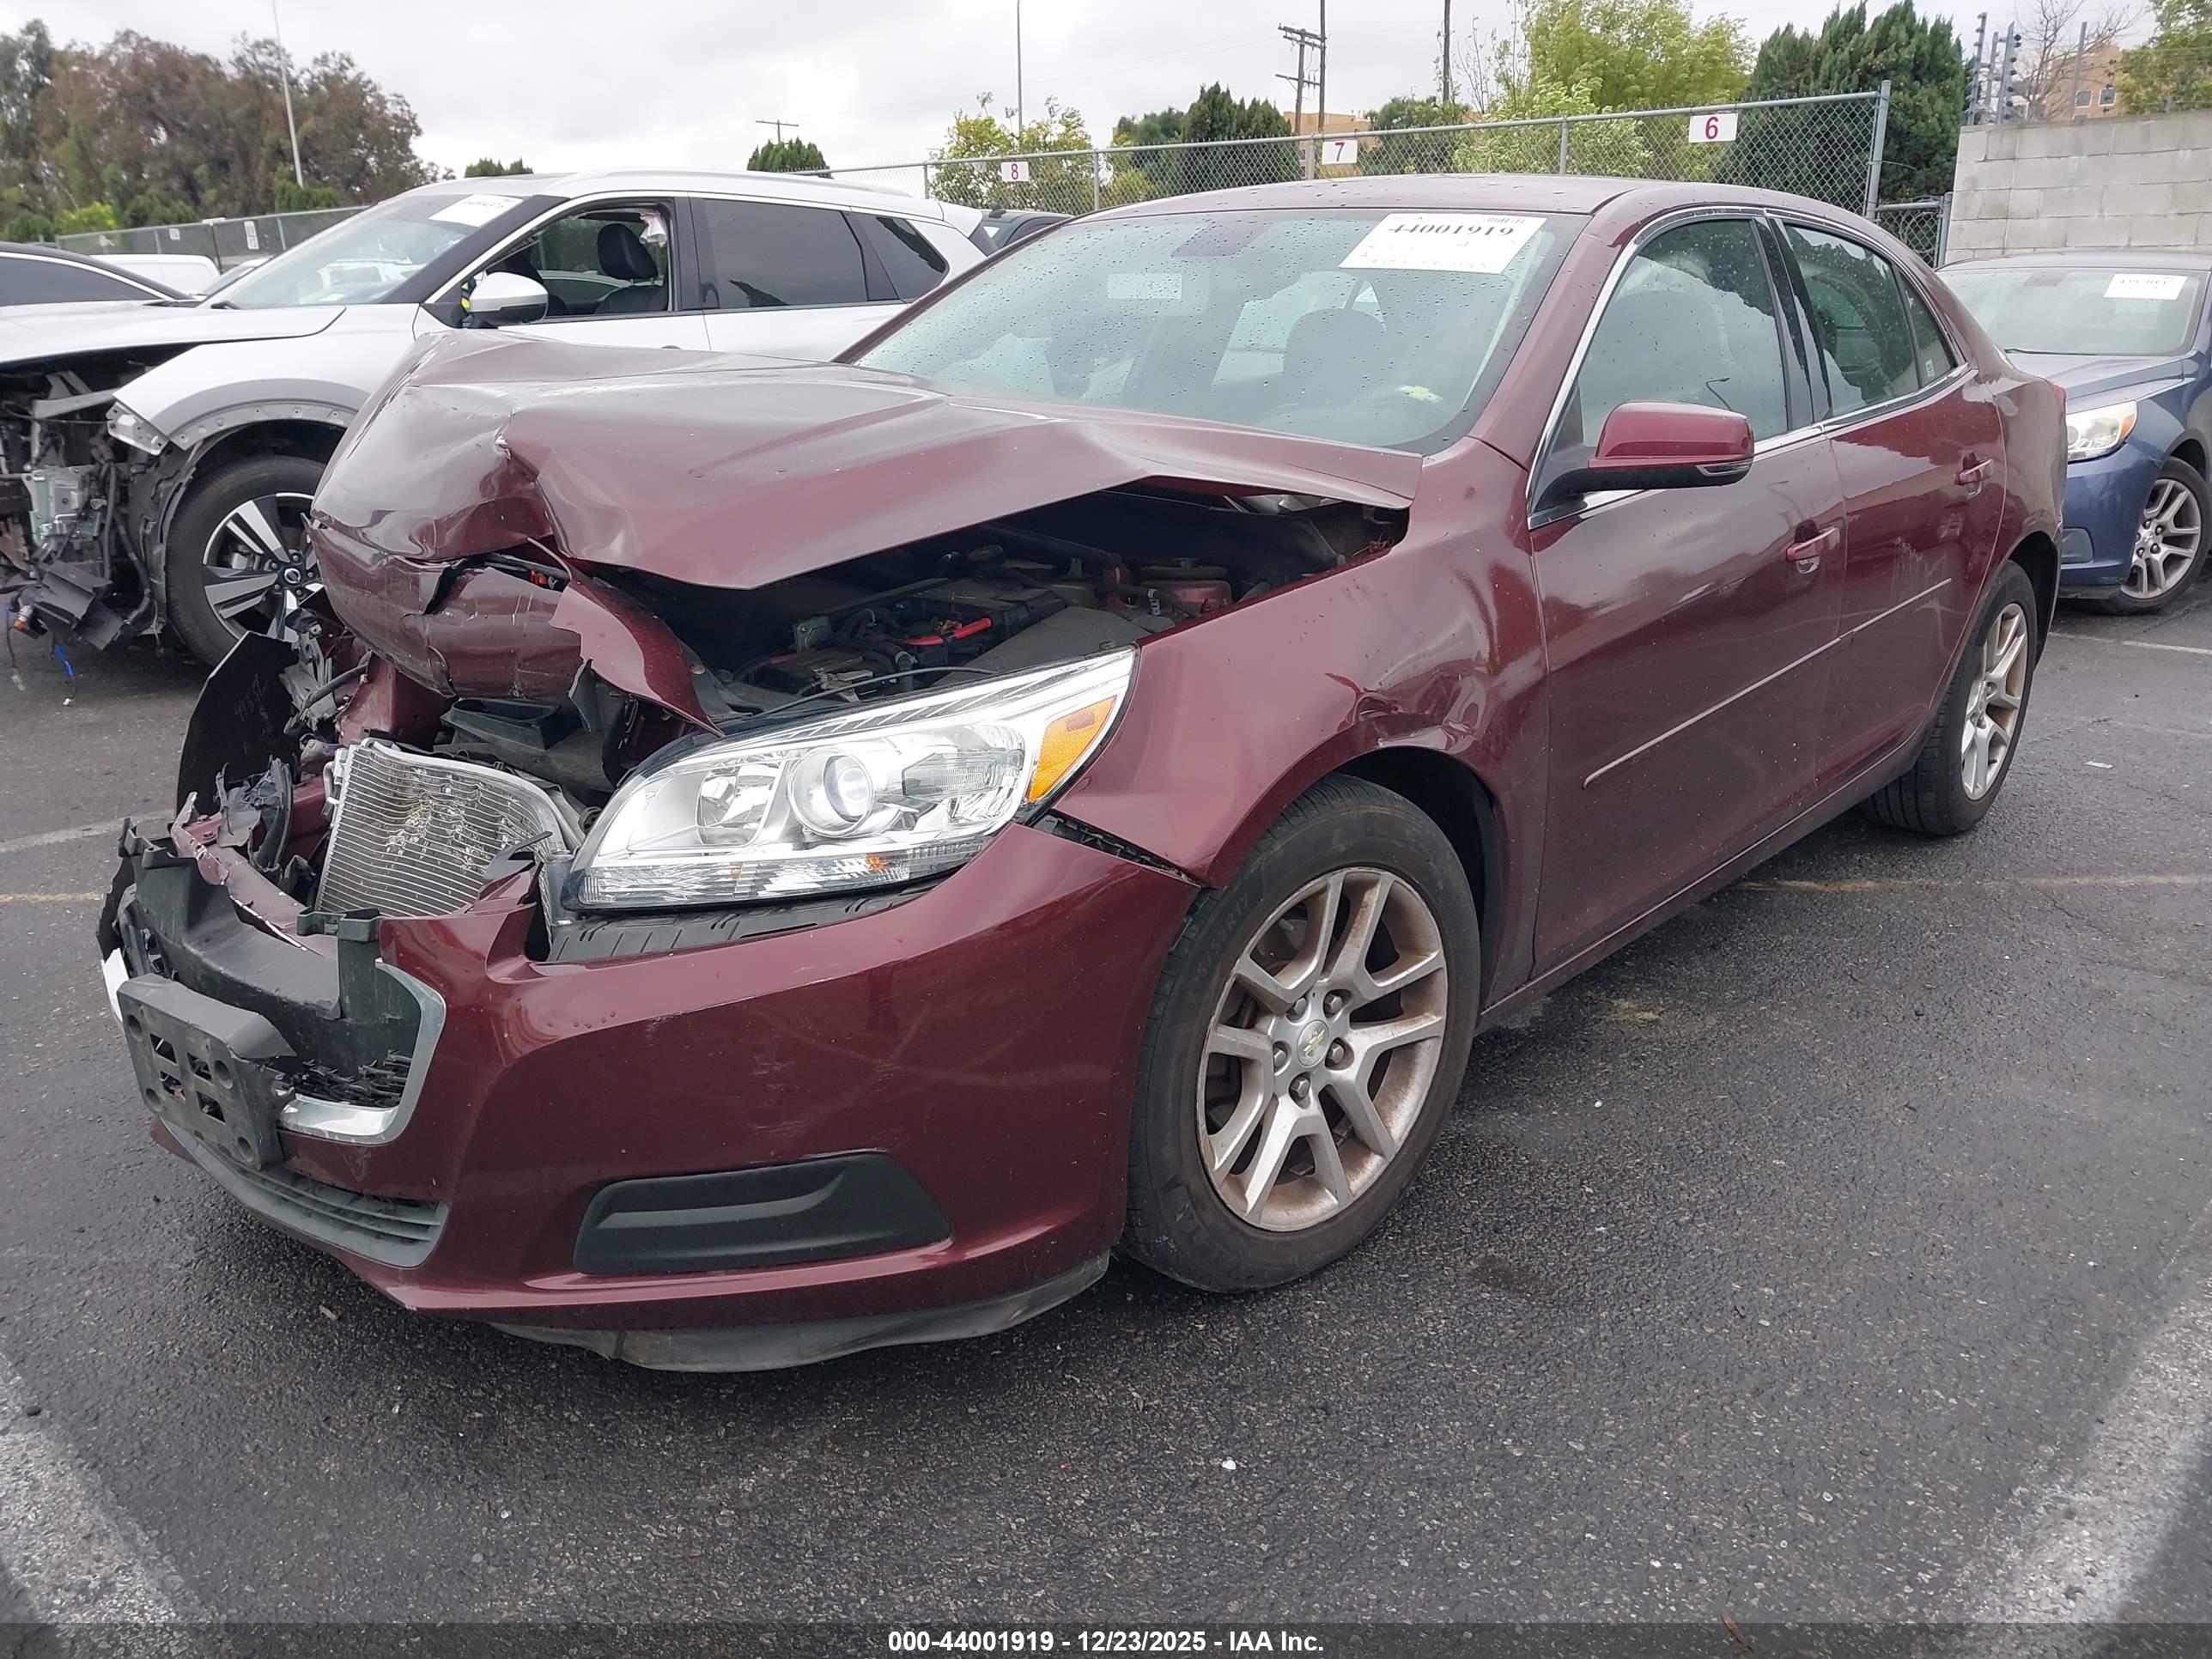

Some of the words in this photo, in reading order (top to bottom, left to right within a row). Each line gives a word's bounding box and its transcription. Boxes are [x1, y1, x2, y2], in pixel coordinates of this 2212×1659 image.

[1705, 117, 1718, 139] 6
[1334, 143, 1345, 161] 7
[1012, 164, 1019, 180] 8
